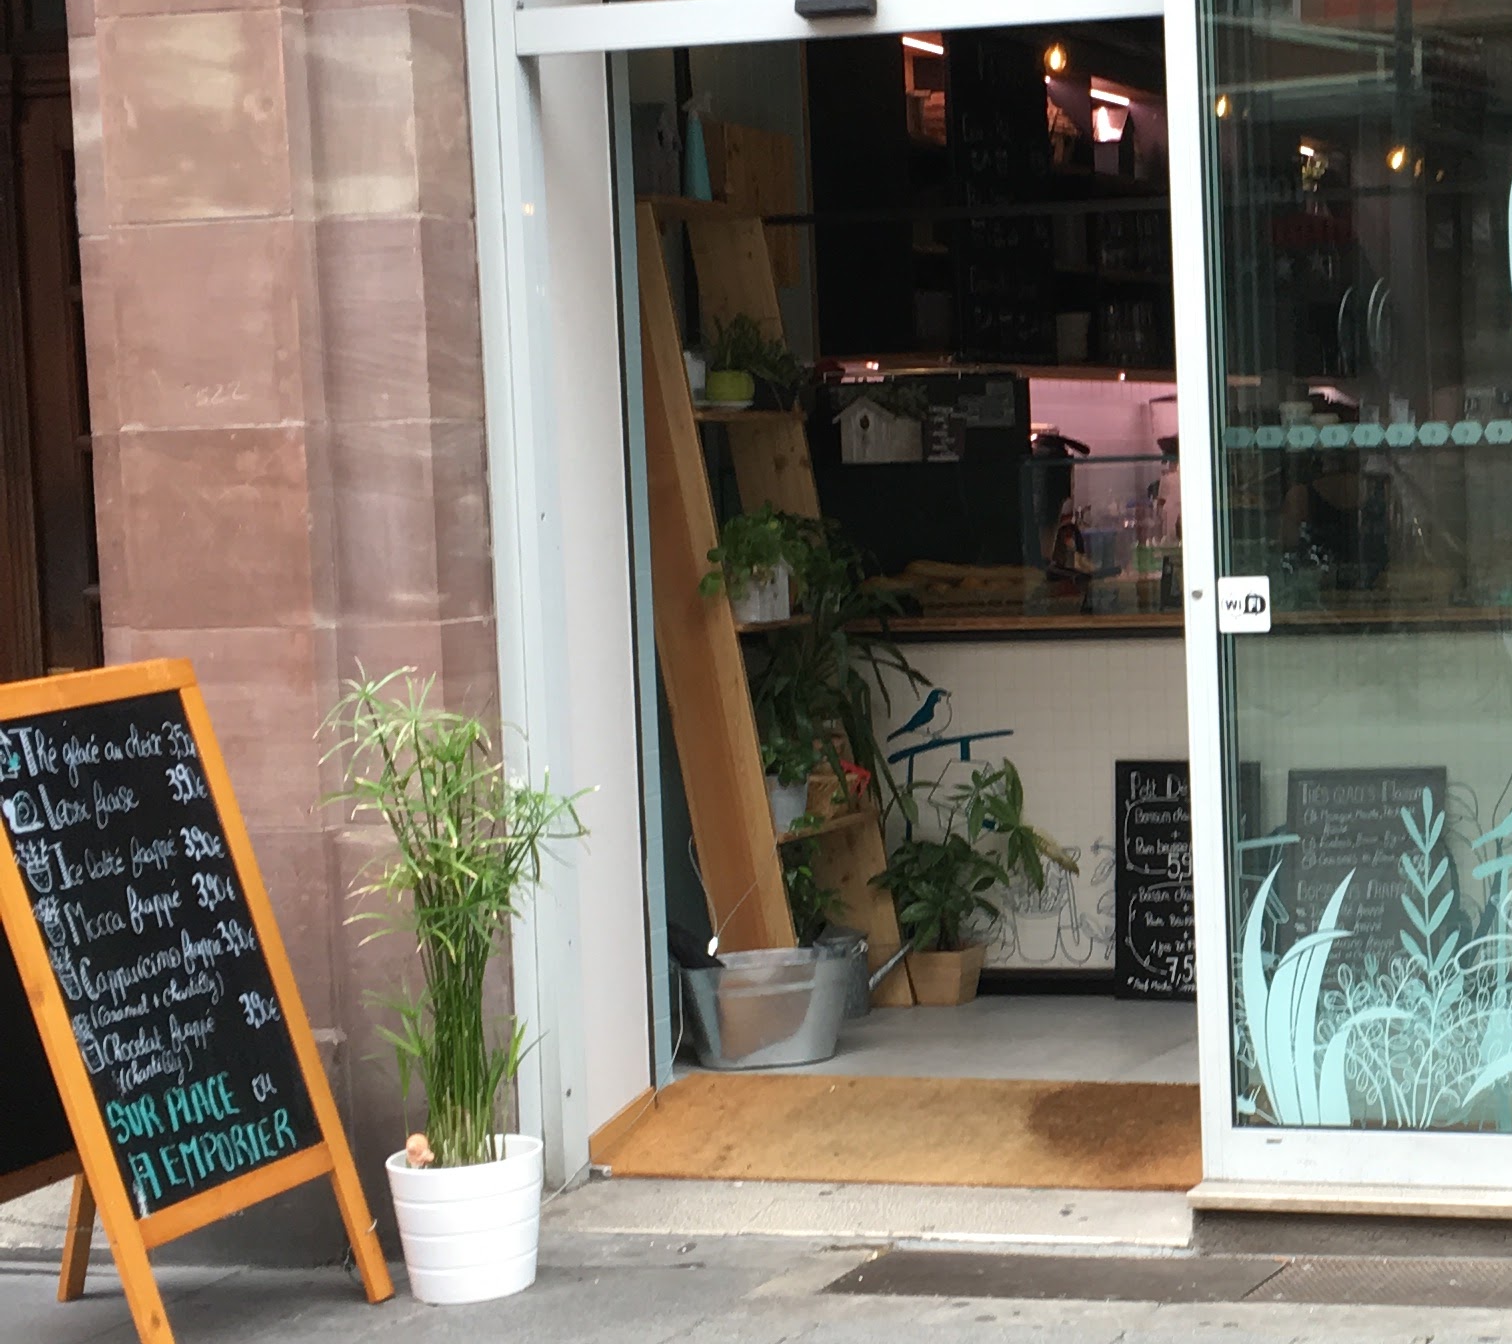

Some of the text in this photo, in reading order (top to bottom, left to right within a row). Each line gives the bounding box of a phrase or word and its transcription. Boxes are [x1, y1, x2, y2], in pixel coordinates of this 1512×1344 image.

[8, 727, 58, 777] Thé
[48, 841, 84, 890] Ice
[105, 1093, 165, 1145] SUR
[164, 1071, 240, 1132] PLACE
[159, 1108, 297, 1189] EMPORTER
